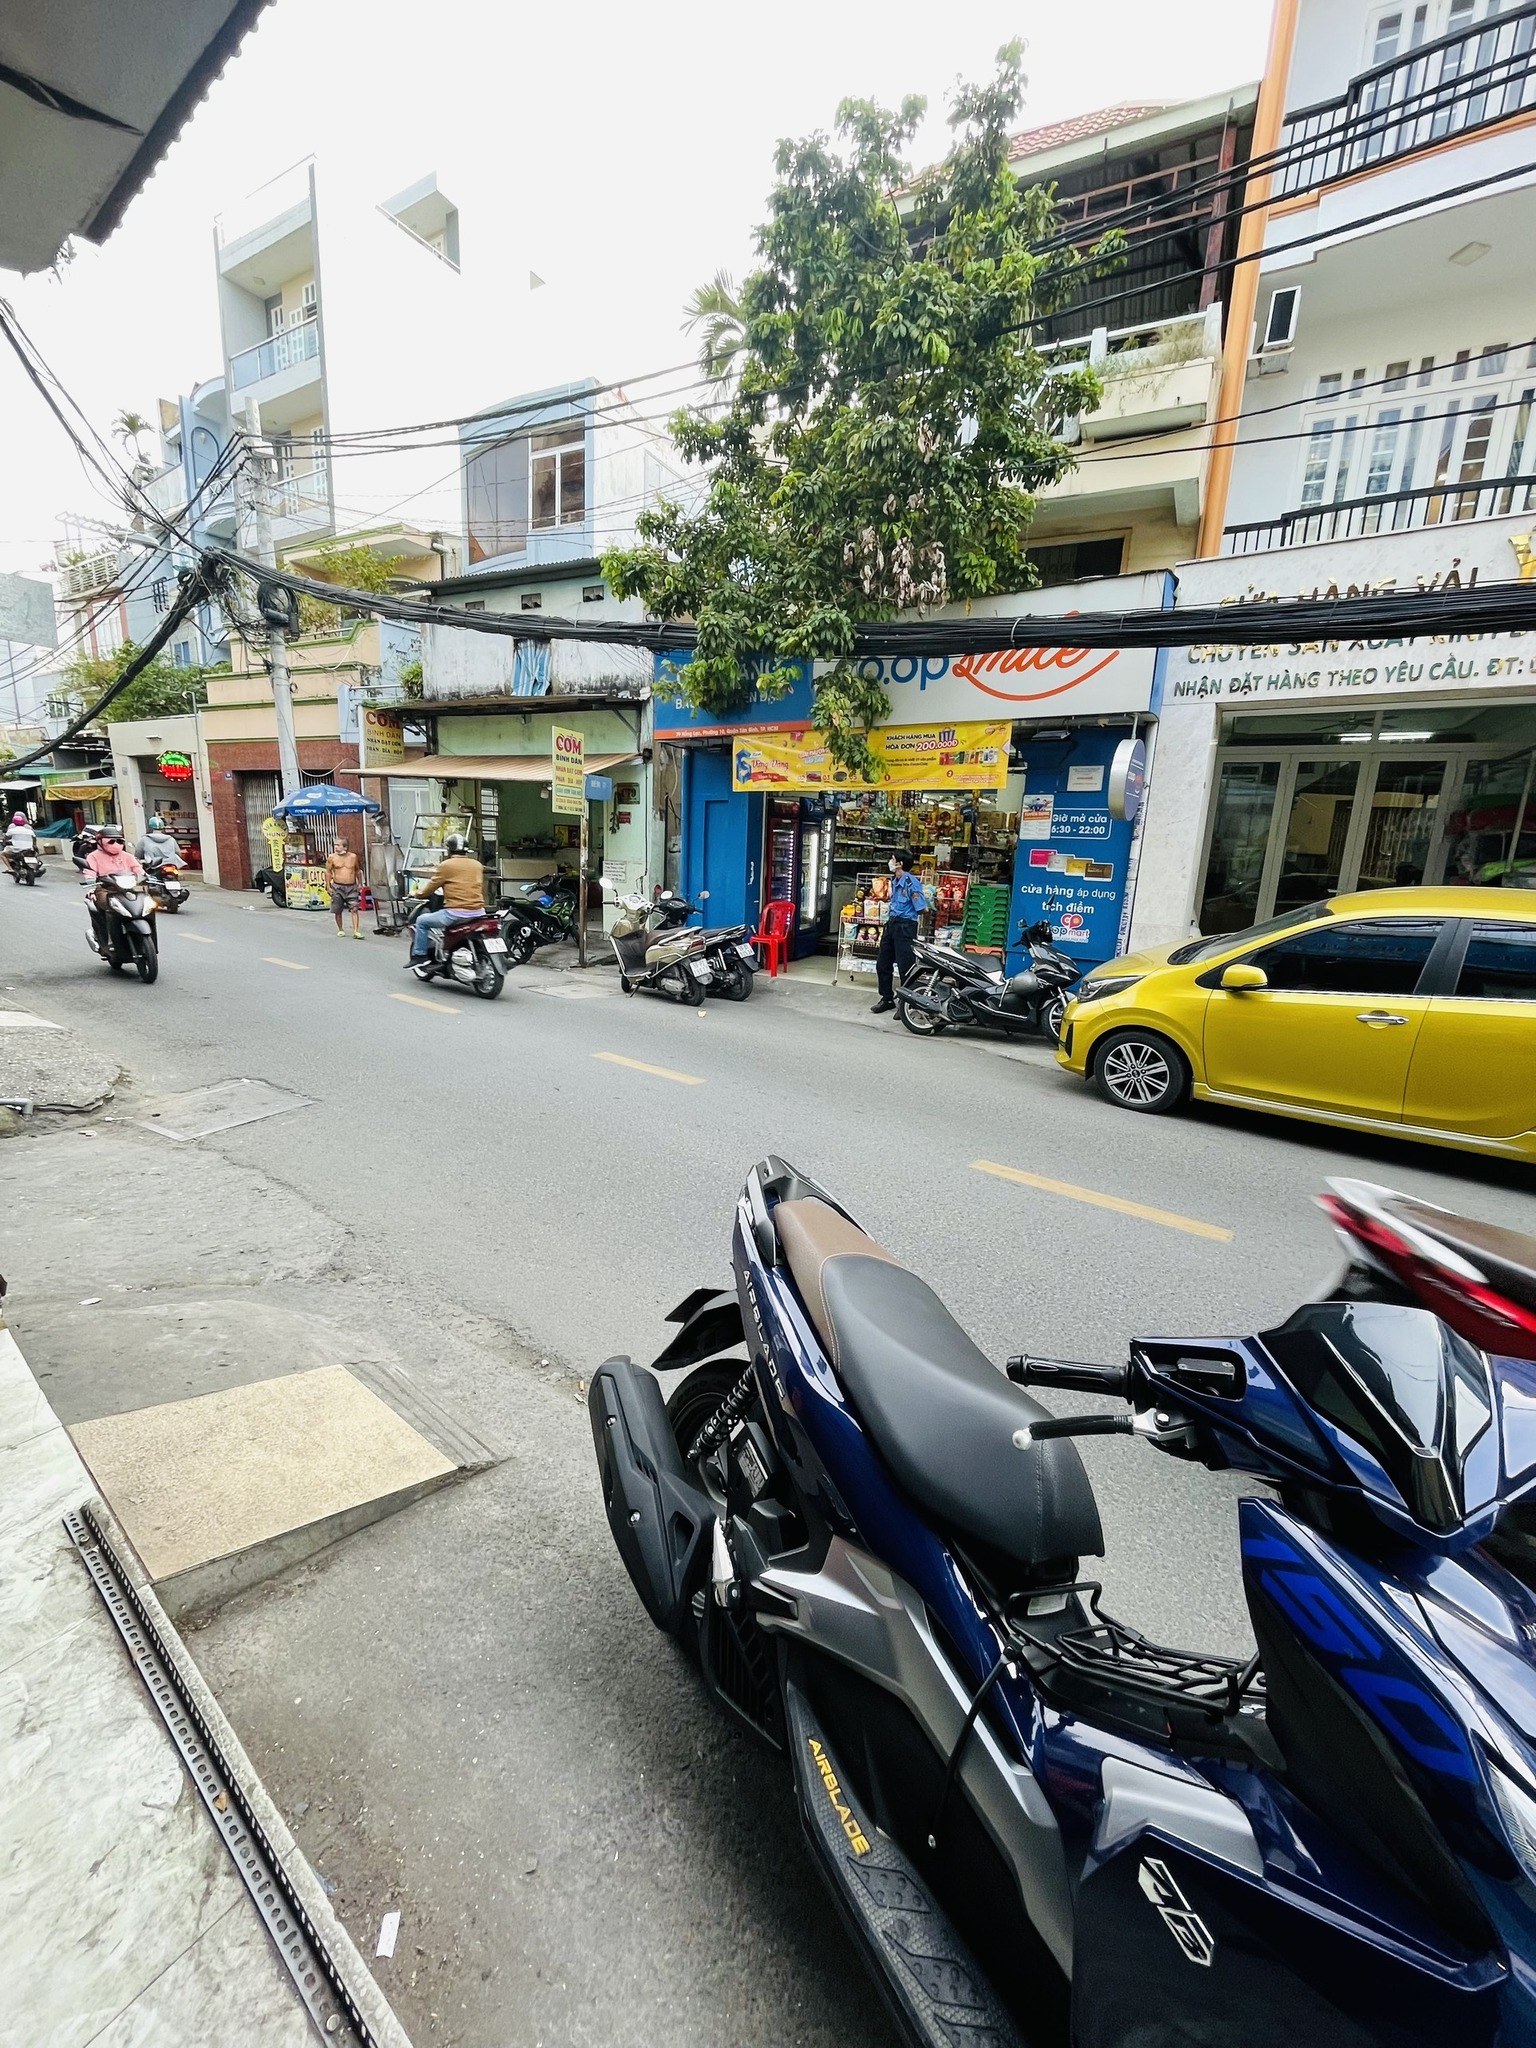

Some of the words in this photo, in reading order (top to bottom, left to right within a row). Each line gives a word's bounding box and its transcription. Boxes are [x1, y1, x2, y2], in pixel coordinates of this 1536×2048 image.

[1174, 675, 1223, 699] NHẬN
[1229, 671, 1263, 695] ĐẶT
[1267, 668, 1321, 690] HÀNG
[1327, 666, 1378, 687] THEO
[1385, 660, 1423, 683] YÊU
[556, 733, 582, 755] CƠM
[886, 733, 905, 741] KHÁCH
[906, 732, 922, 740] HÀNG
[1052, 813, 1067, 823] Giờ
[1070, 813, 1085, 823] mở
[1088, 813, 1107, 823] cửa
[1051, 825, 1070, 834] 6:30
[1078, 825, 1106, 835] 22:00
[1021, 883, 1043, 895] cửa
[1045, 885, 1074, 898] hàng
[1076, 886, 1089, 898] áp
[1091, 888, 1117, 900] dụng
[1066, 901, 1095, 914] điểm
[808, 1737, 872, 1856] AIRBLADE
